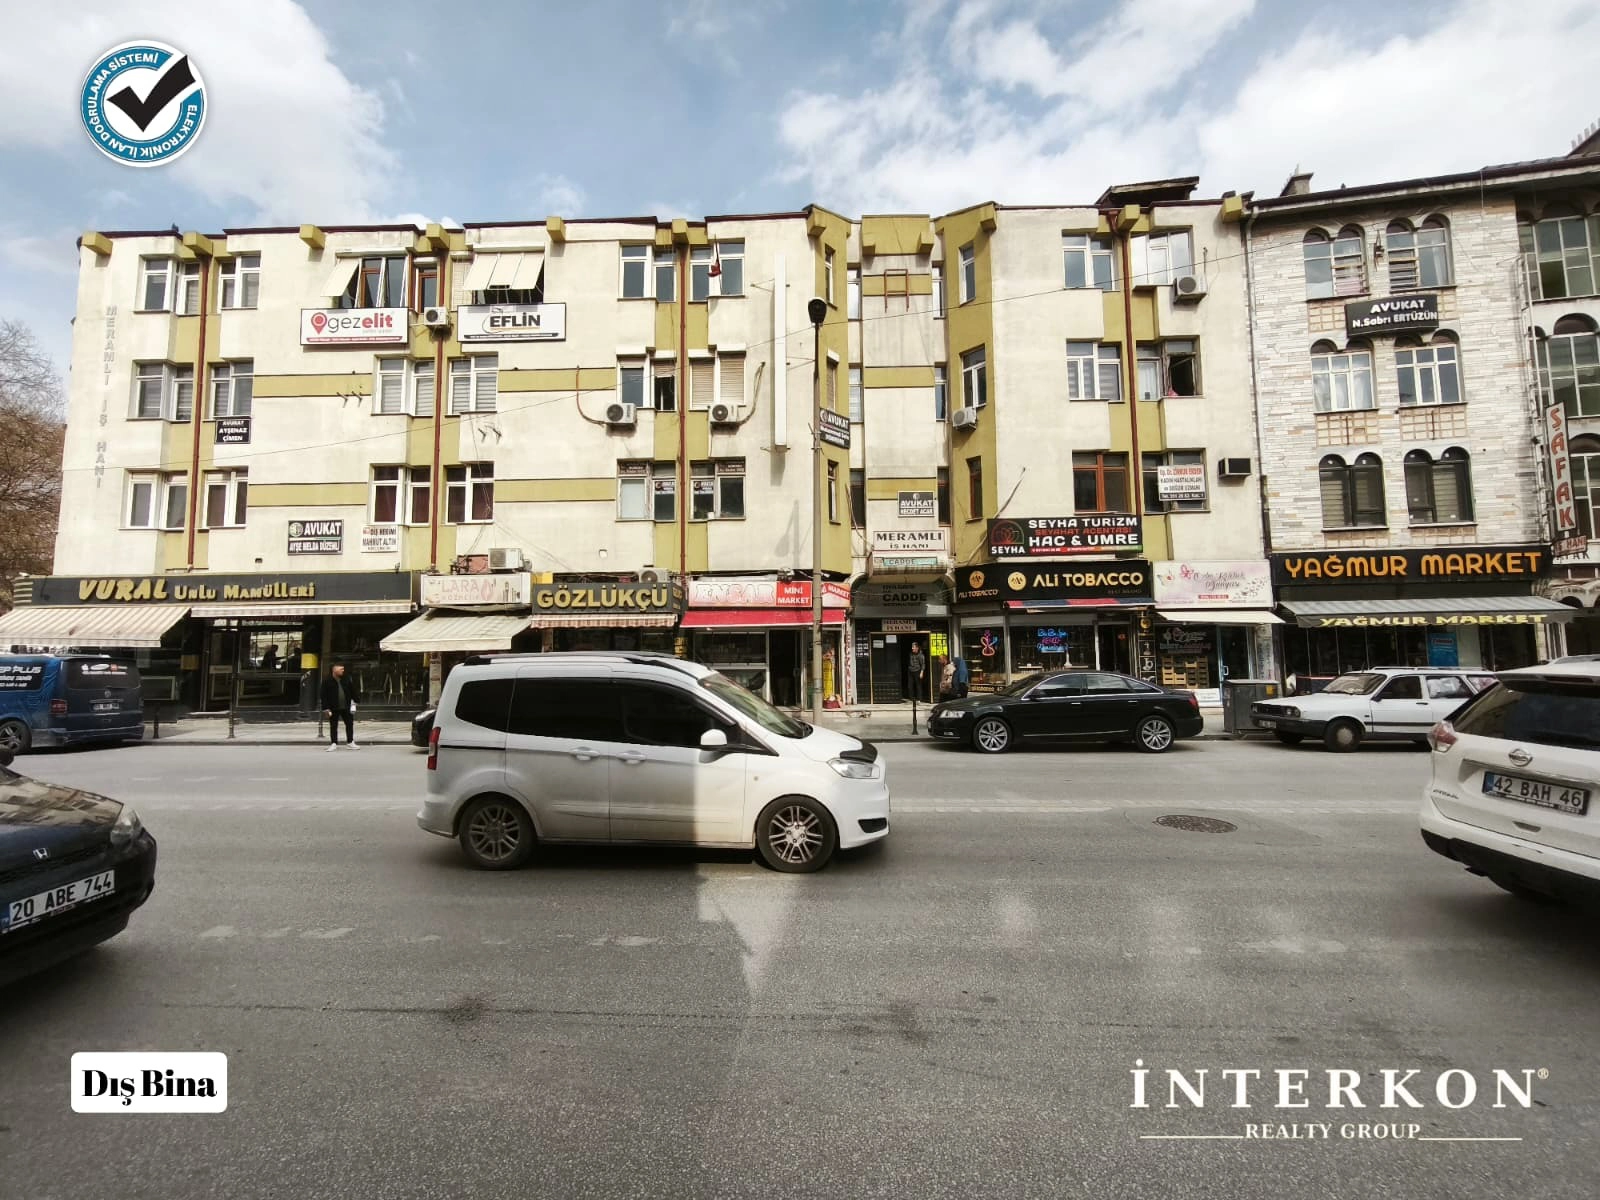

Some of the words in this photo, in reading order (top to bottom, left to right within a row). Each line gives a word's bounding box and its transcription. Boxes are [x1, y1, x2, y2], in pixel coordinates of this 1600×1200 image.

[1370, 300, 1426, 314] AVUKAT
[327, 313, 393, 333] gezelit
[489, 312, 541, 328] EFLİN
[1393, 310, 1438, 323] ERTÜZÜN
[827, 412, 849, 430] AVUKAT
[304, 522, 341, 536] AVUKAT
[1028, 519, 1077, 529] SEYHA
[1082, 517, 1138, 528] TURİZM
[876, 532, 942, 541] MERAMLI
[1028, 535, 1066, 547] HAC
[1070, 535, 1083, 546] &
[1087, 534, 1139, 546] UMRE
[991, 545, 1026, 554] SEYHA
[1285, 555, 1408, 578] YAĞMUR
[1421, 551, 1542, 576] MARKET
[1062, 572, 1143, 587] TOBACCO
[78, 578, 168, 601] VURAL
[537, 584, 668, 611] GÖZLÜKÇÜ
[777, 596, 810, 604] MARKET
[882, 592, 928, 602] CADDE
[1319, 614, 1426, 627] YAĞMUR
[1436, 613, 1548, 625] MARKET
[1494, 776, 1513, 794] 42
[1520, 782, 1551, 801] BAH
[1559, 789, 1582, 807] 46
[12, 898, 34, 922] 20
[45, 884, 76, 911] ABE
[84, 873, 111, 897] 744
